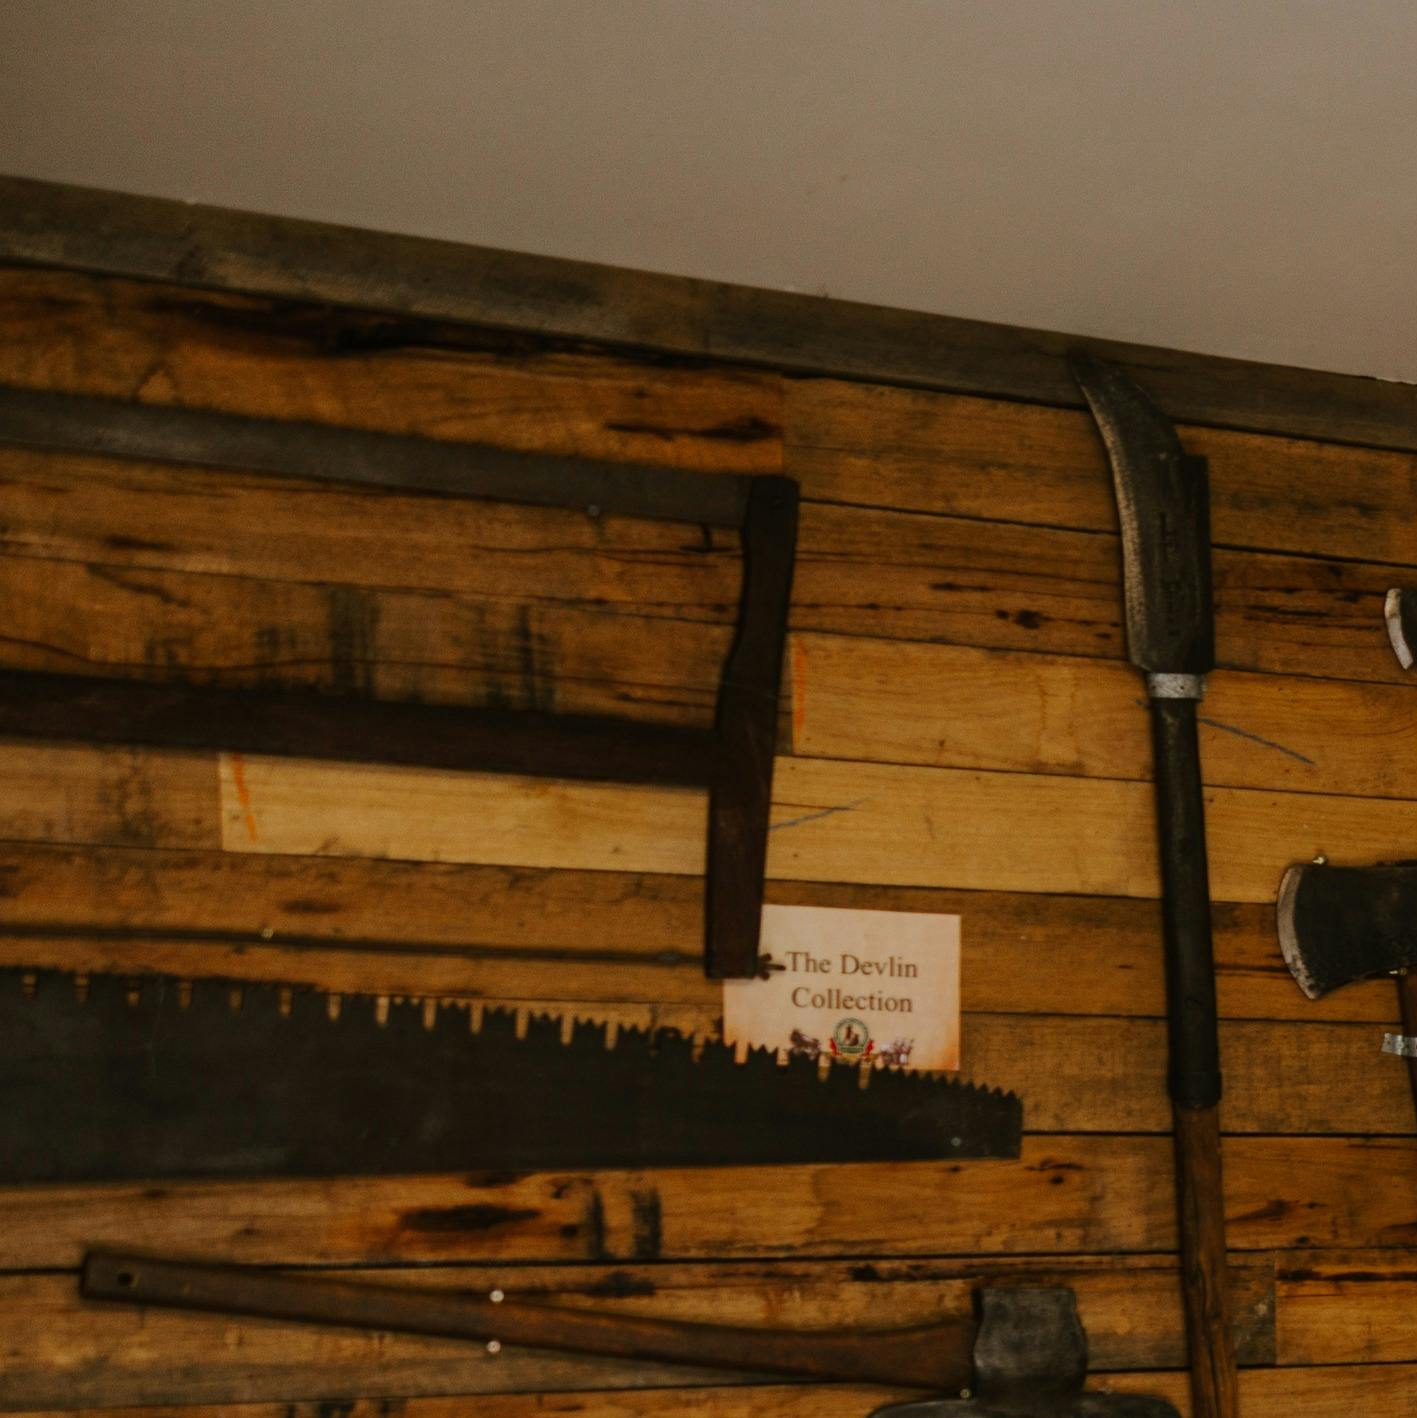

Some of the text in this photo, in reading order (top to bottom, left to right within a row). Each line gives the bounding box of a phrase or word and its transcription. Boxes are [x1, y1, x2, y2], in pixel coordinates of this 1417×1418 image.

[785, 952, 918, 978] The Devlin
[791, 987, 913, 1013] Collection
